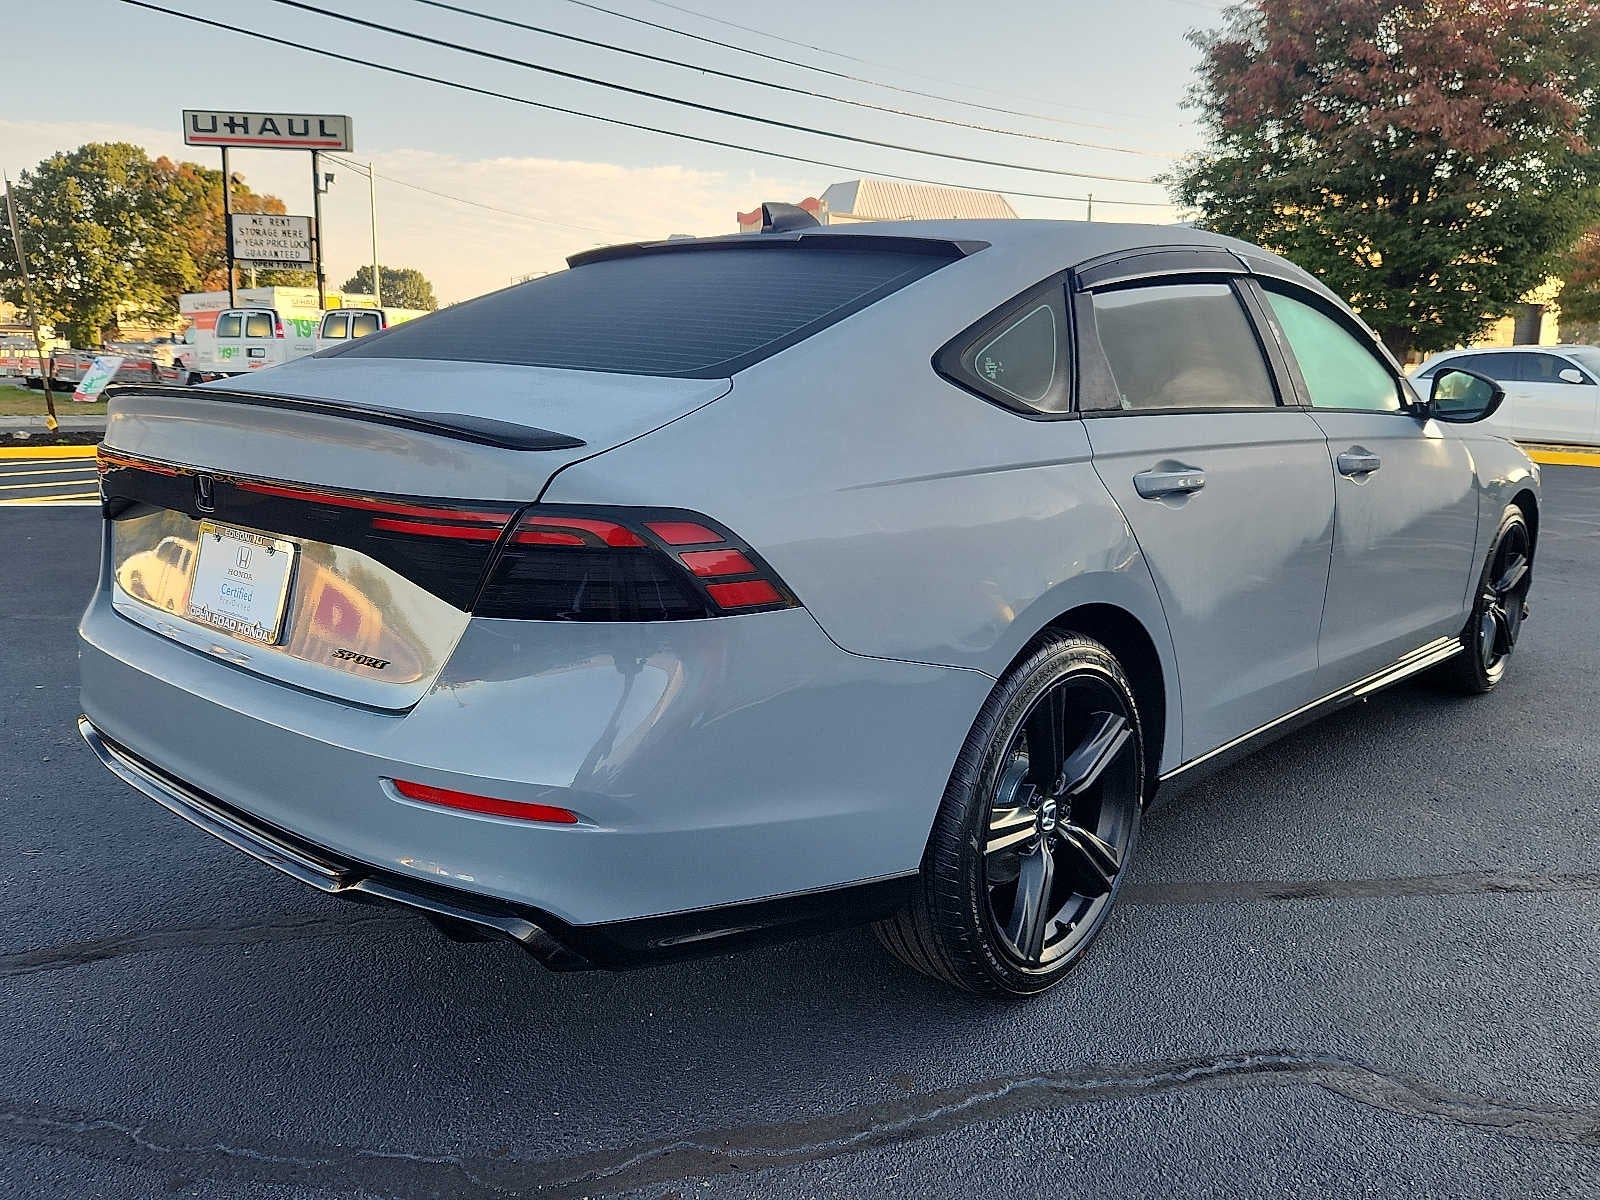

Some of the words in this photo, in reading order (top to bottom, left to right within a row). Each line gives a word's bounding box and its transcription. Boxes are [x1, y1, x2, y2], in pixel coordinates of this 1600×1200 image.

[269, 218, 291, 227] RENT
[239, 227, 277, 237] STORAGE
[281, 229, 303, 239] HERE
[266, 239, 288, 248] PRICE
[244, 249, 301, 259] GUARANTEED
[252, 260, 273, 268] OPEN
[227, 568, 254, 581] HONDA
[221, 583, 253, 602] Certified
[213, 612, 237, 630] ROAD
[237, 621, 269, 642] HONDA
[331, 648, 391, 670] SPORT
